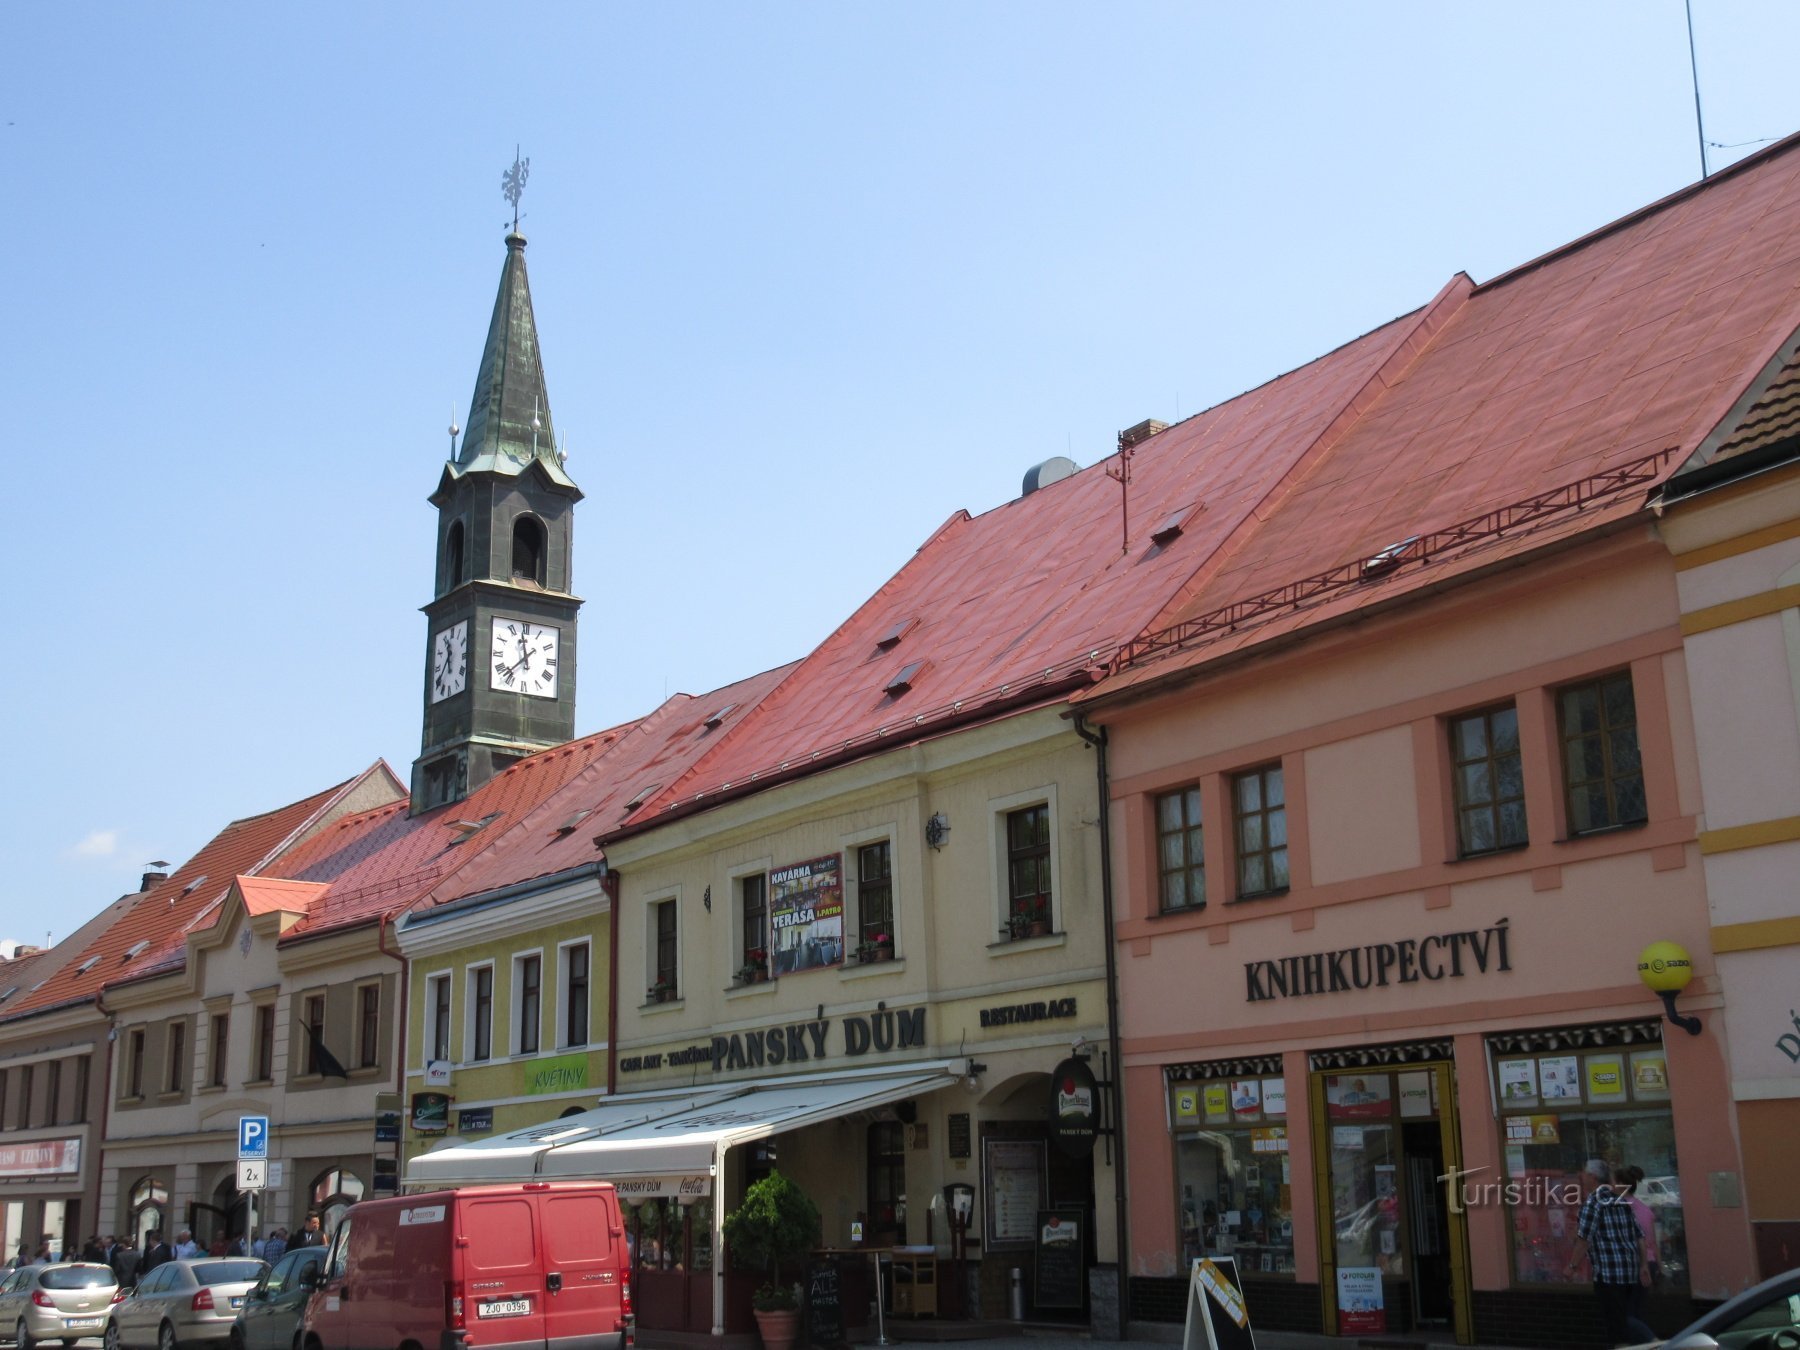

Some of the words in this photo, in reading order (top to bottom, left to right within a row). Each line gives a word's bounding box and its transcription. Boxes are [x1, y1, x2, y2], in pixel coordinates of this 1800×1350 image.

[771, 866, 811, 884] KAVÁRNA
[772, 908, 815, 929] TERASA
[1244, 917, 1512, 1002] KNIHKUPECTVÍ
[980, 997, 1077, 1027] RESTAURACE
[711, 1004, 830, 1071] PANSKÝ
[843, 1001, 926, 1056] DŮM
[535, 1066, 585, 1088] KVĚTINY
[245, 1122, 261, 1145] P
[622, 1179, 646, 1193] PANSKÝ
[647, 1178, 661, 1191] DŮM
[811, 1280, 838, 1295] ALE
[486, 1304, 500, 1314] 2J0
[506, 1301, 526, 1312] 0396
